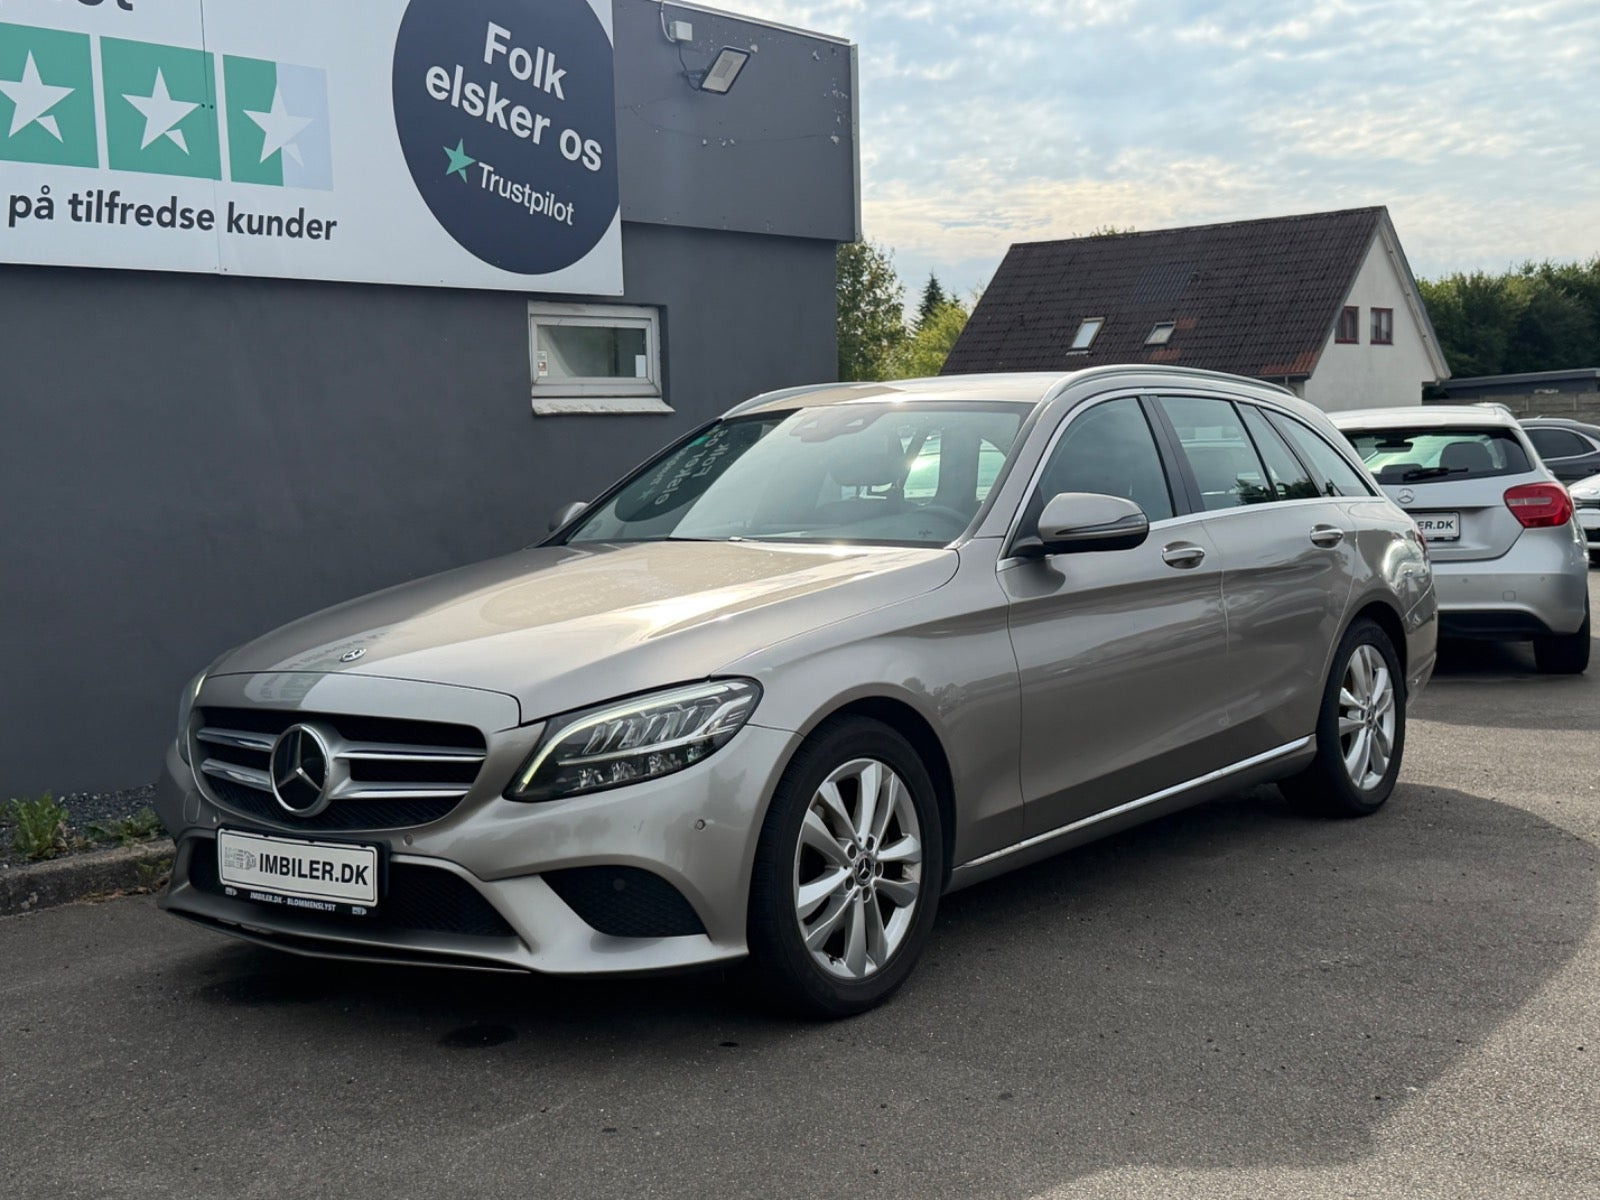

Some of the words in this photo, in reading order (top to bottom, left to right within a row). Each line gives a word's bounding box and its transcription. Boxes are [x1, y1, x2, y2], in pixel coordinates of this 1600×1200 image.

[483, 21, 567, 100] Folk
[425, 64, 550, 145] elsker
[559, 128, 602, 171] os
[8, 185, 54, 227] på
[68, 190, 215, 231] tilfredse
[226, 202, 337, 240] kunder
[478, 162, 574, 225] Trustpilot
[250, 892, 283, 904] IMBILER.DK
[259, 853, 369, 886] IMBILER.DK
